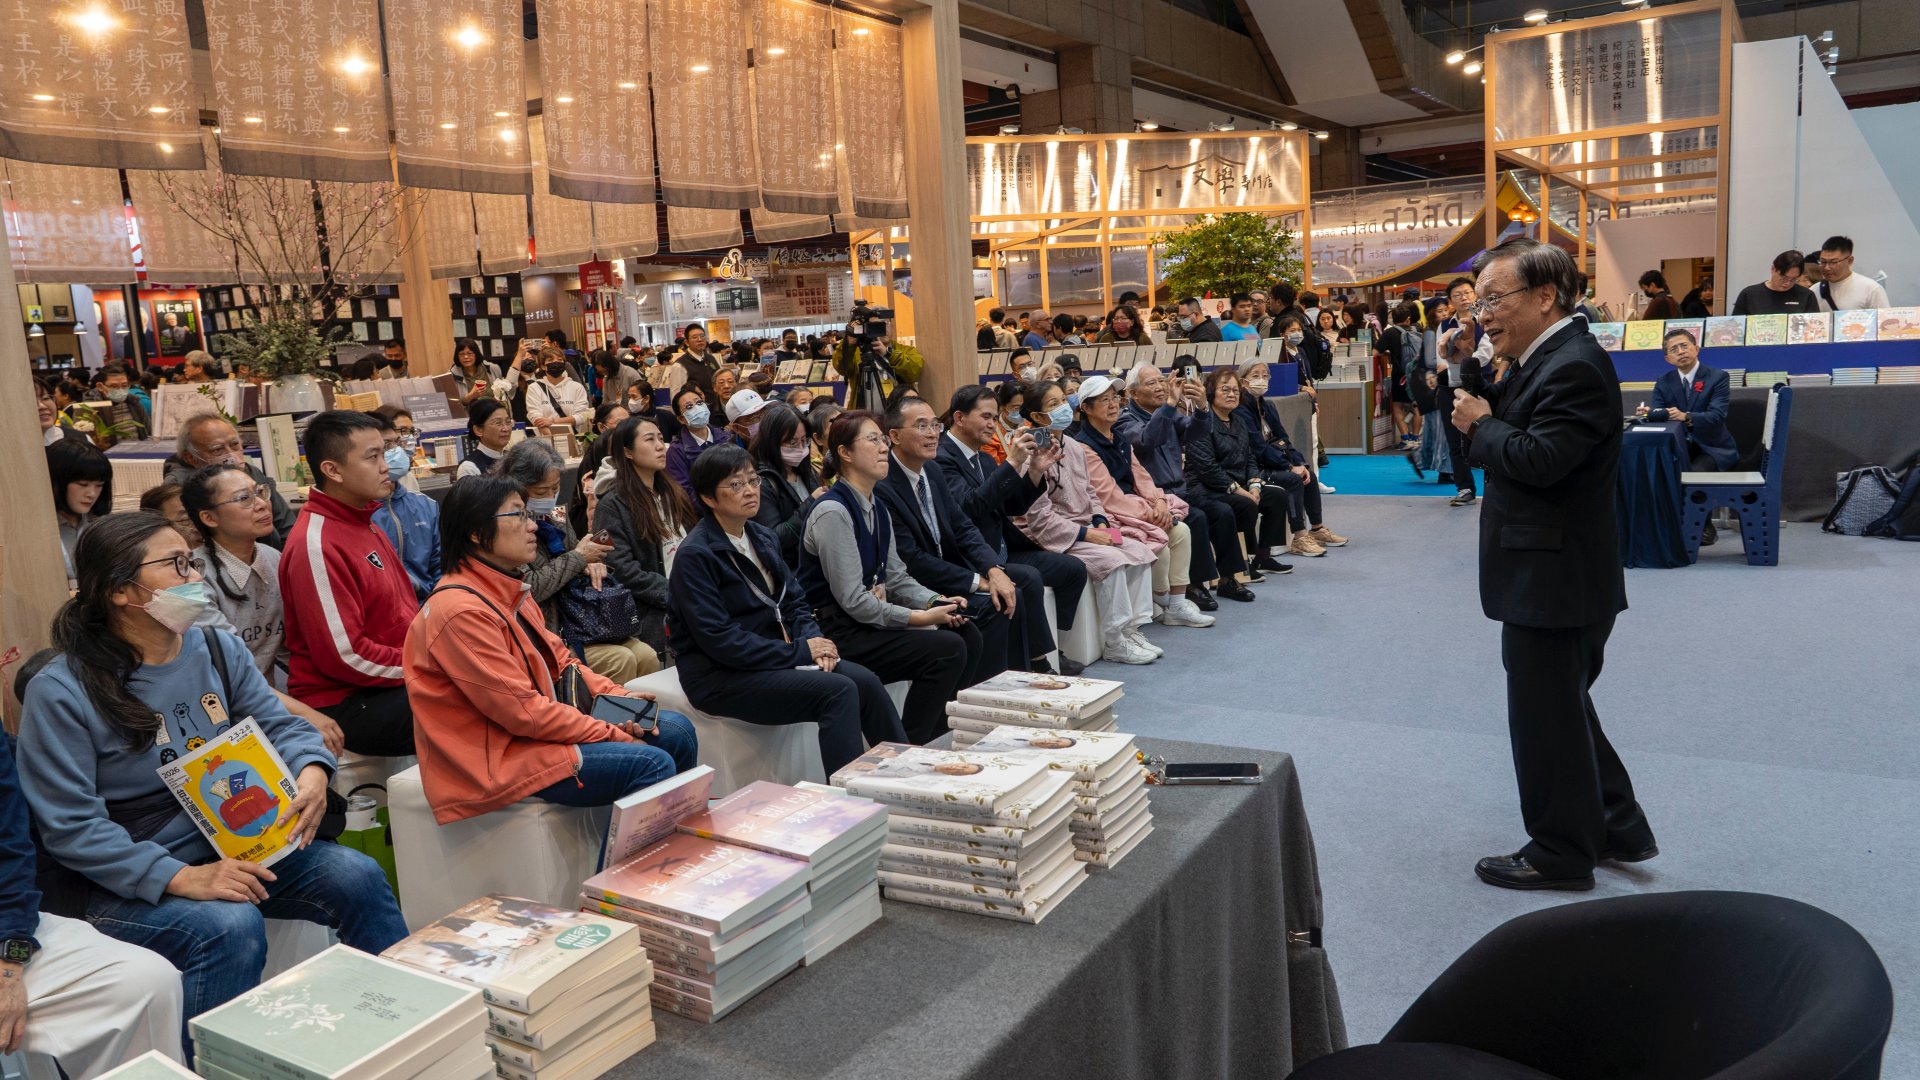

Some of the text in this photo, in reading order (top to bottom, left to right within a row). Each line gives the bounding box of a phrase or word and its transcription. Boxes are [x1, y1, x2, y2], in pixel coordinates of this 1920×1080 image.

[207, 0, 236, 133] 奴婢人民唯
[1612, 41, 1622, 111] 紀州庵文學森林
[1341, 219, 1377, 236] สวัสดี
[1382, 194, 1463, 232] สวัสดี
[157, 304, 193, 313] 黃仁勳傳
[162, 767, 180, 779] 2026
[176, 789, 218, 837] 台北國際書展
[637, 845, 734, 896] 的溫柔
[668, 852, 762, 902] 刀鋒下
